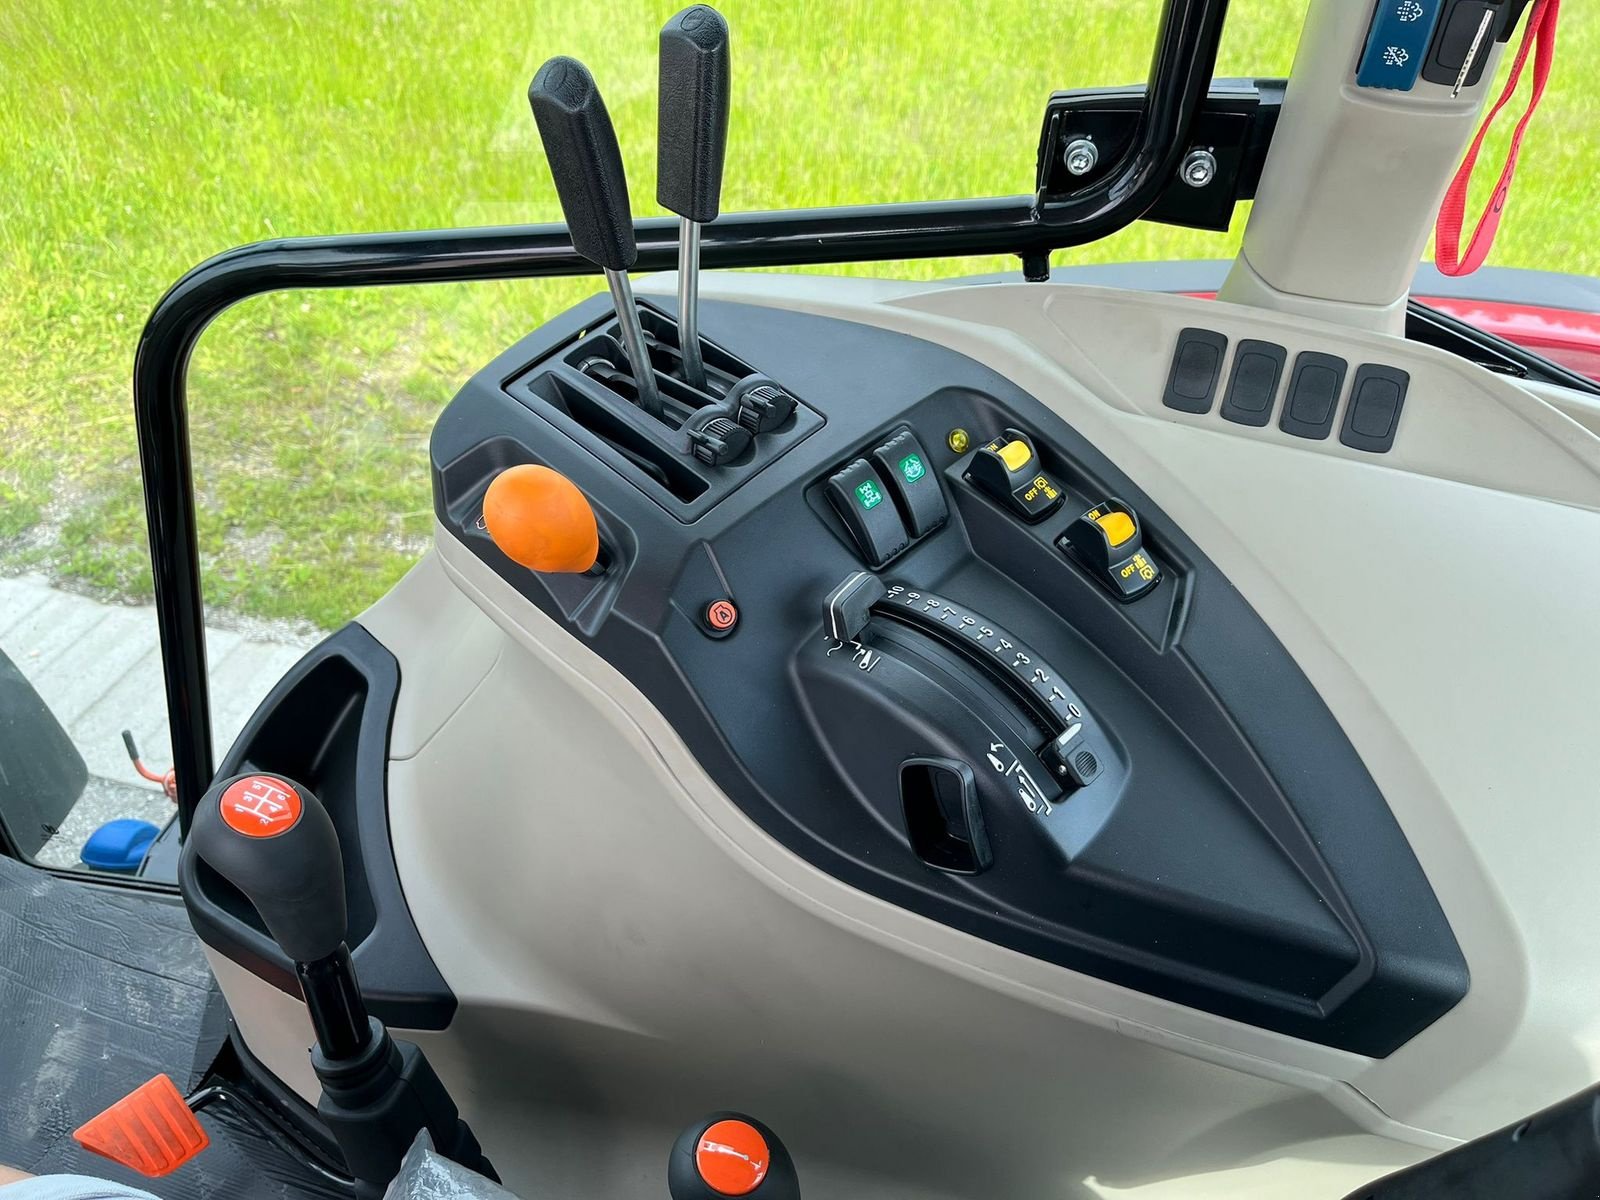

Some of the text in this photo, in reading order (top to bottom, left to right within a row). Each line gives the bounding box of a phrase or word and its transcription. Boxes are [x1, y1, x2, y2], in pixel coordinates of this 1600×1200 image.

[1024, 487, 1038, 501] OFF
[1088, 509, 1101, 520] ON
[1120, 565, 1135, 578] OFF
[887, 585, 1082, 718] 10 9 8 7 6 5 4 3 2 1 0
